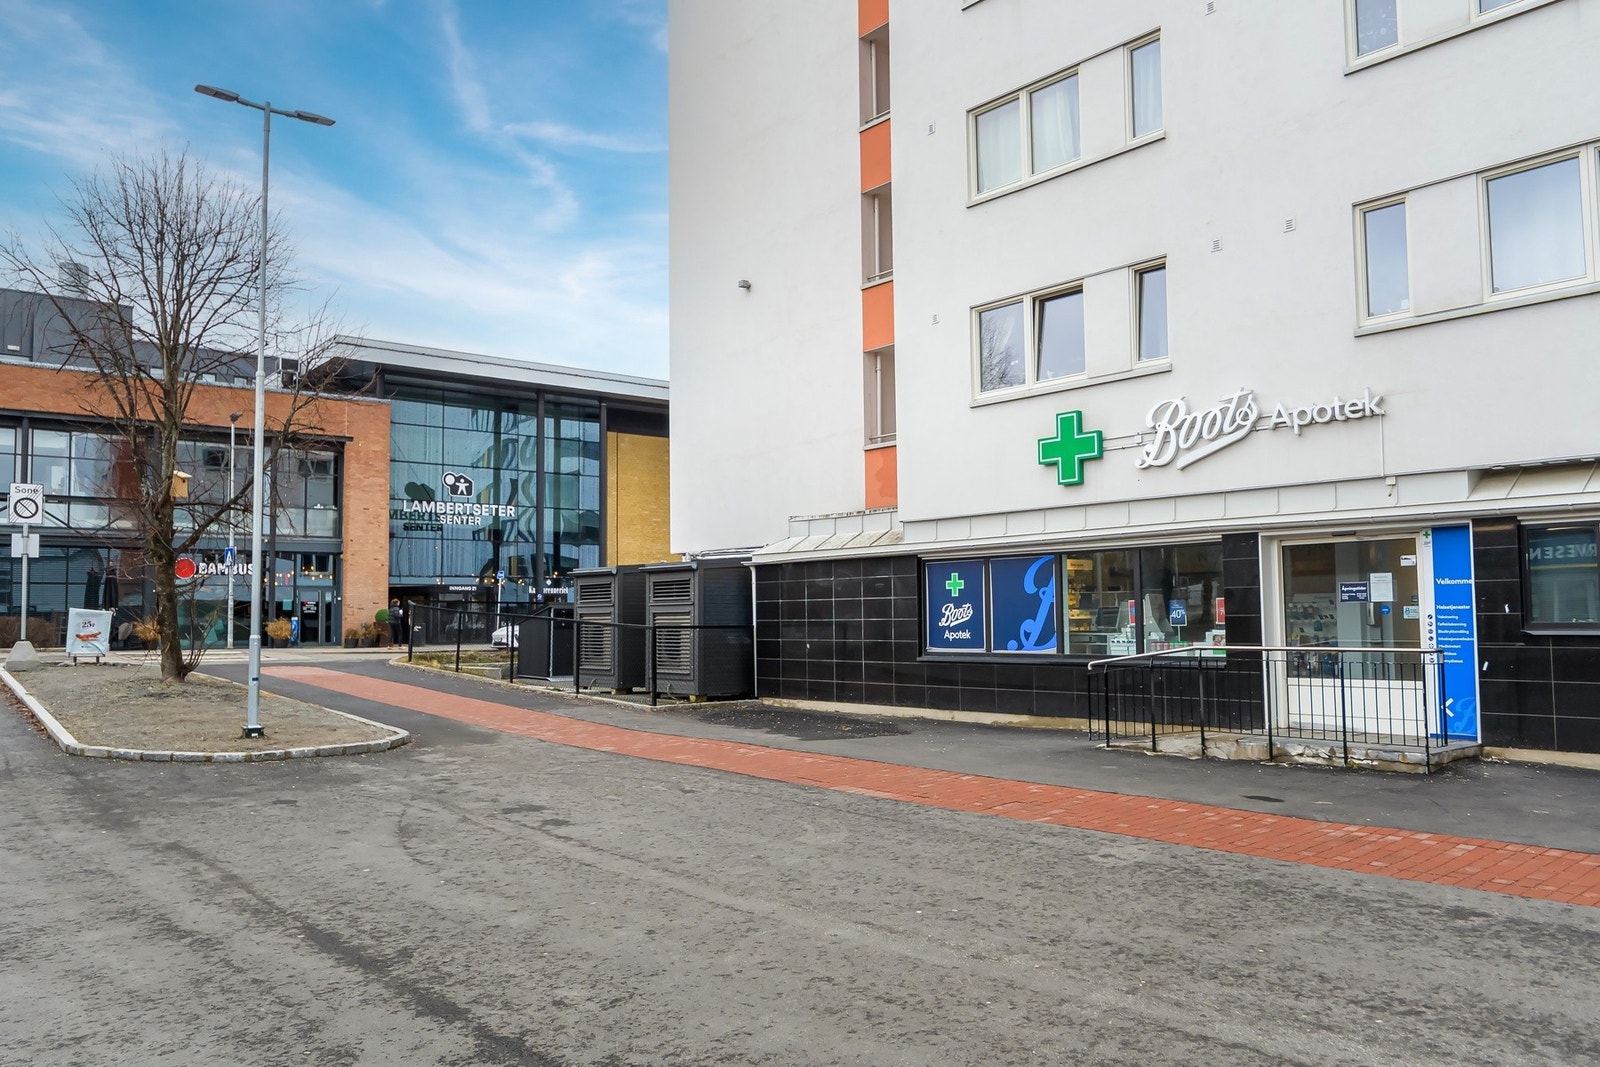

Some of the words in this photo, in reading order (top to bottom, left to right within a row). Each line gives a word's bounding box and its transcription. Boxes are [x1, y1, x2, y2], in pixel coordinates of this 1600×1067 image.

[1134, 387, 1262, 470] Boots
[1267, 387, 1386, 437] Apotek
[403, 500, 515, 517] LAMBERTSETER
[440, 515, 481, 526] SENTER
[938, 603, 973, 628] Boots
[1170, 608, 1186, 619] 40%
[944, 629, 971, 642] Apotek
